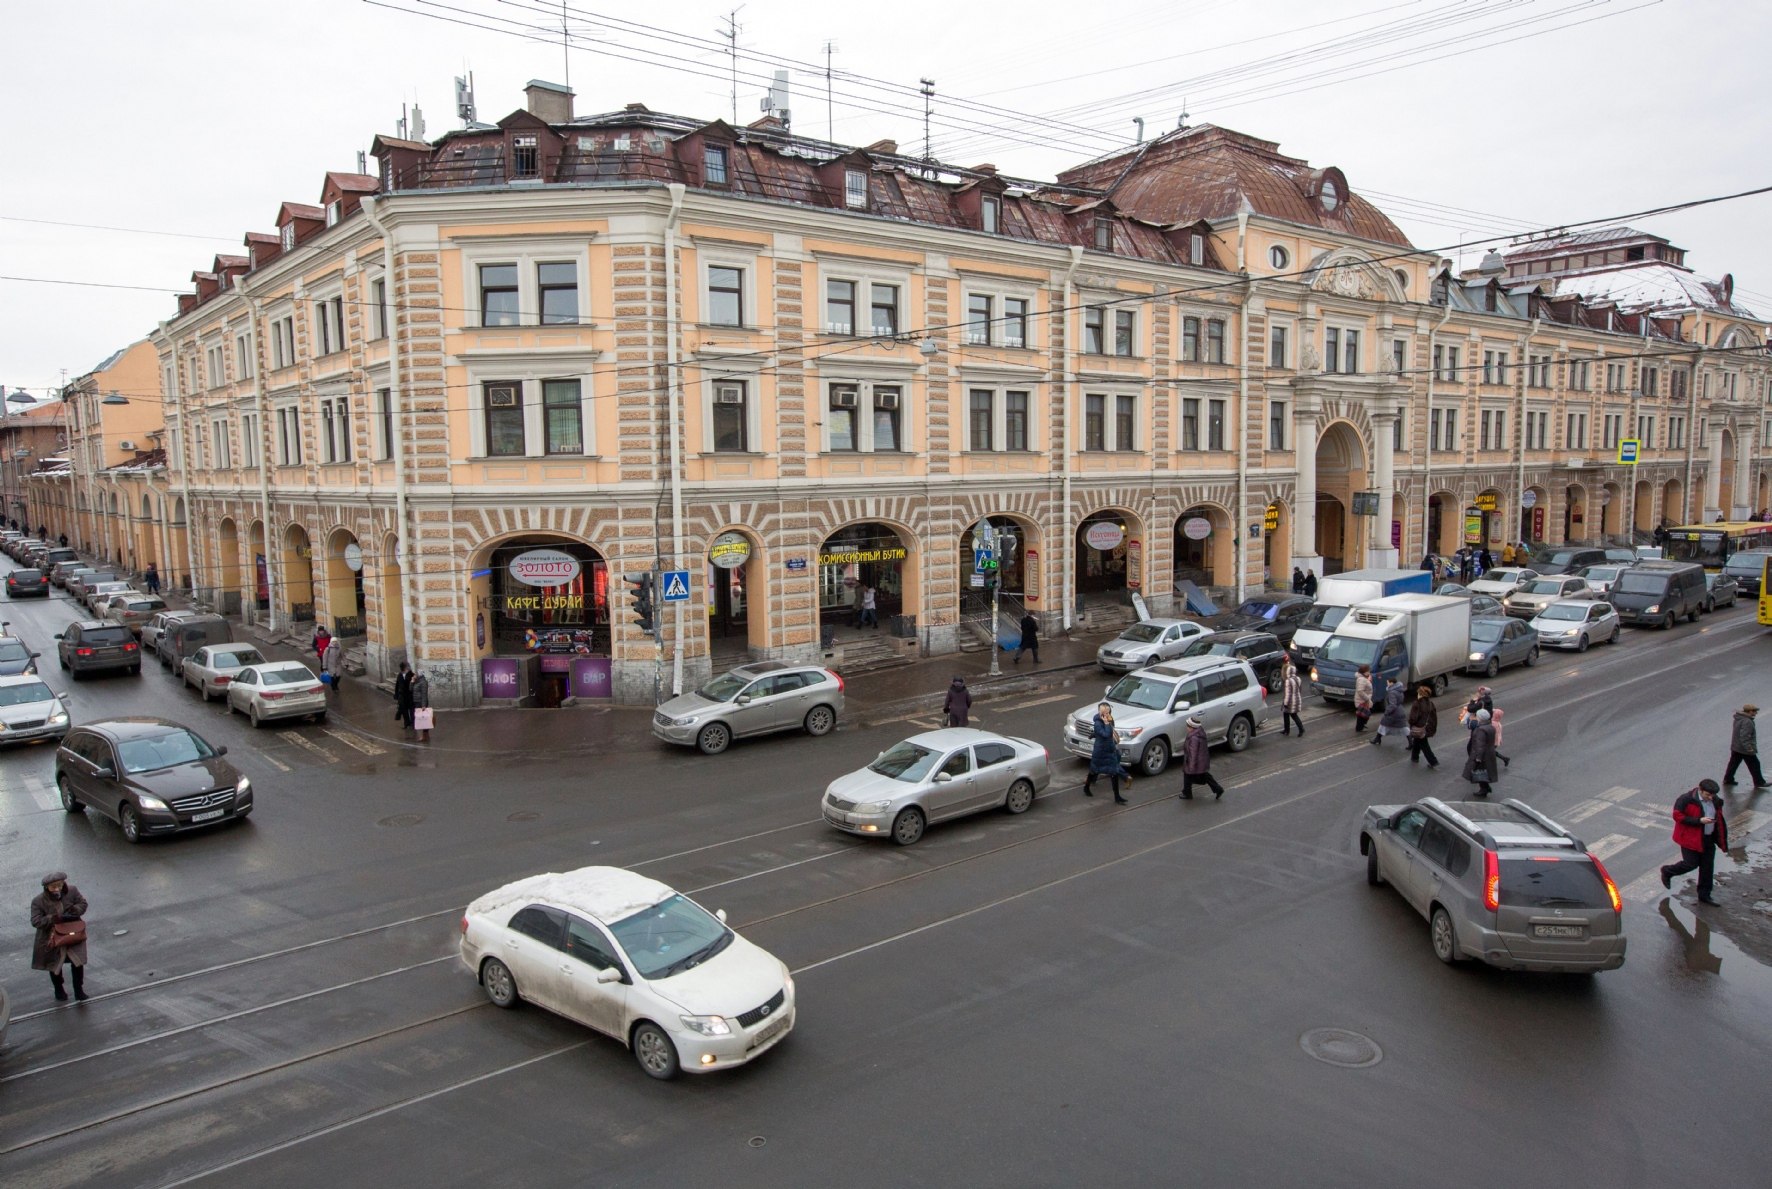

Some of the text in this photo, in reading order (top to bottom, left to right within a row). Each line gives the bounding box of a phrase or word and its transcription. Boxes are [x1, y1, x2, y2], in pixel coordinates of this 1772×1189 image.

[818, 550, 880, 565] КОМИССИОННЫЙ
[882, 548, 906, 560] БУТИК
[517, 562, 573, 573] ЗОЛОТО
[507, 596, 583, 609] КАФЕ ДУБАЙ
[484, 673, 517, 684] КАФЕ
[583, 672, 606, 684] БАР
